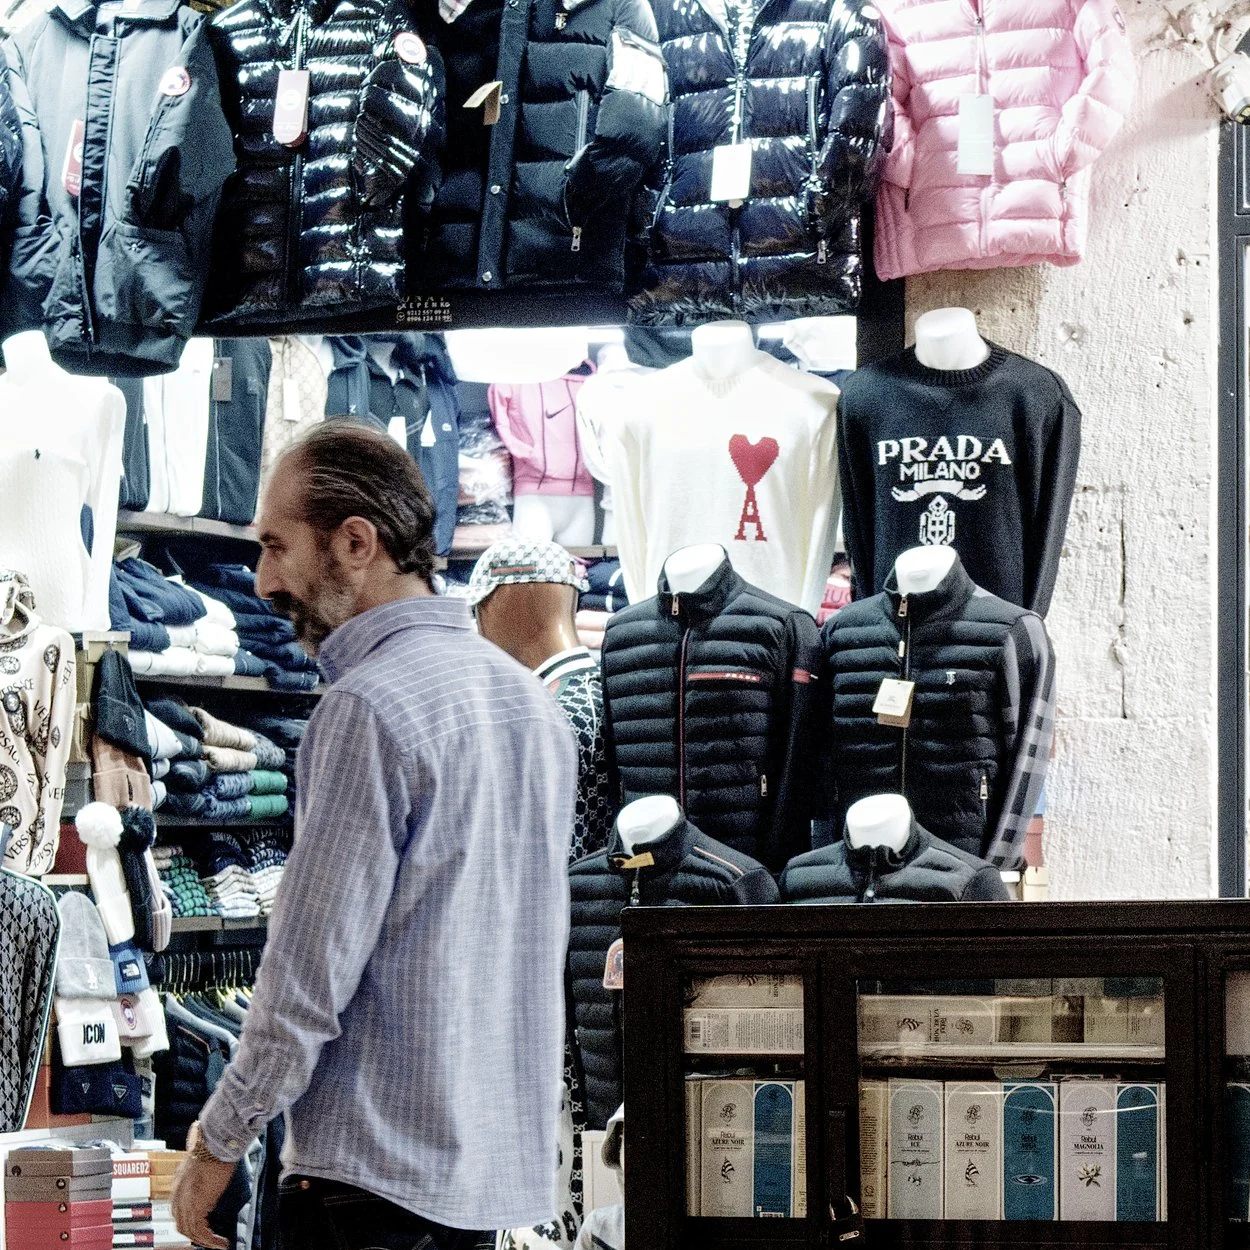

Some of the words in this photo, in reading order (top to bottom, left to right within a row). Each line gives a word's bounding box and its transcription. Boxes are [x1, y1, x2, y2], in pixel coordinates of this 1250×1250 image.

[877, 435, 1012, 465] PRADA
[900, 461, 981, 481] MILANO
[82, 1023, 106, 1045] ICON
[112, 1161, 150, 1176] SQUARED2
